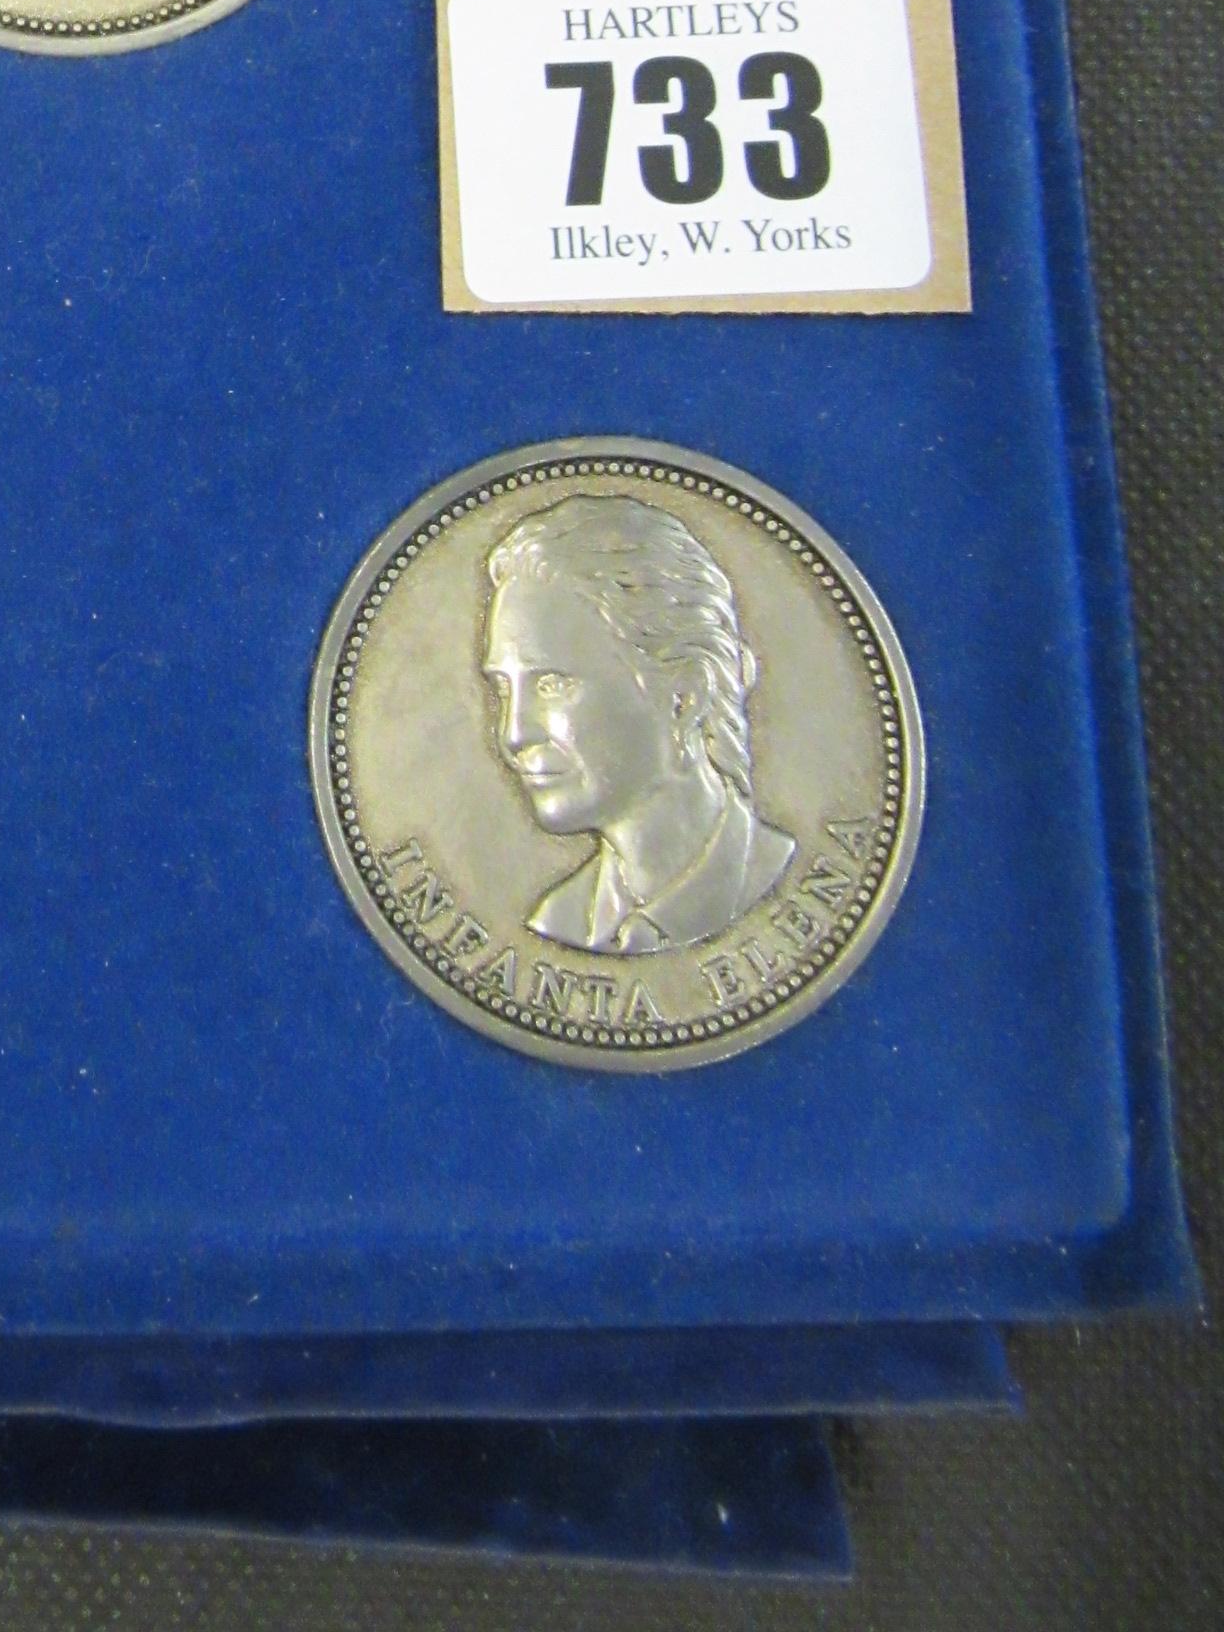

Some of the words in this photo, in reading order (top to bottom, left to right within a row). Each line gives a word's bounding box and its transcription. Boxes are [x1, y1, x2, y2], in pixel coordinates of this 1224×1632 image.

[563, 0, 801, 42] HARTLEYS
[544, 51, 832, 207] 733
[551, 223, 669, 266] Ilkley,
[680, 220, 731, 255] W.
[742, 217, 852, 253] Yorks
[377, 836, 667, 1028] INFANTA
[698, 815, 872, 1006] ELENA
